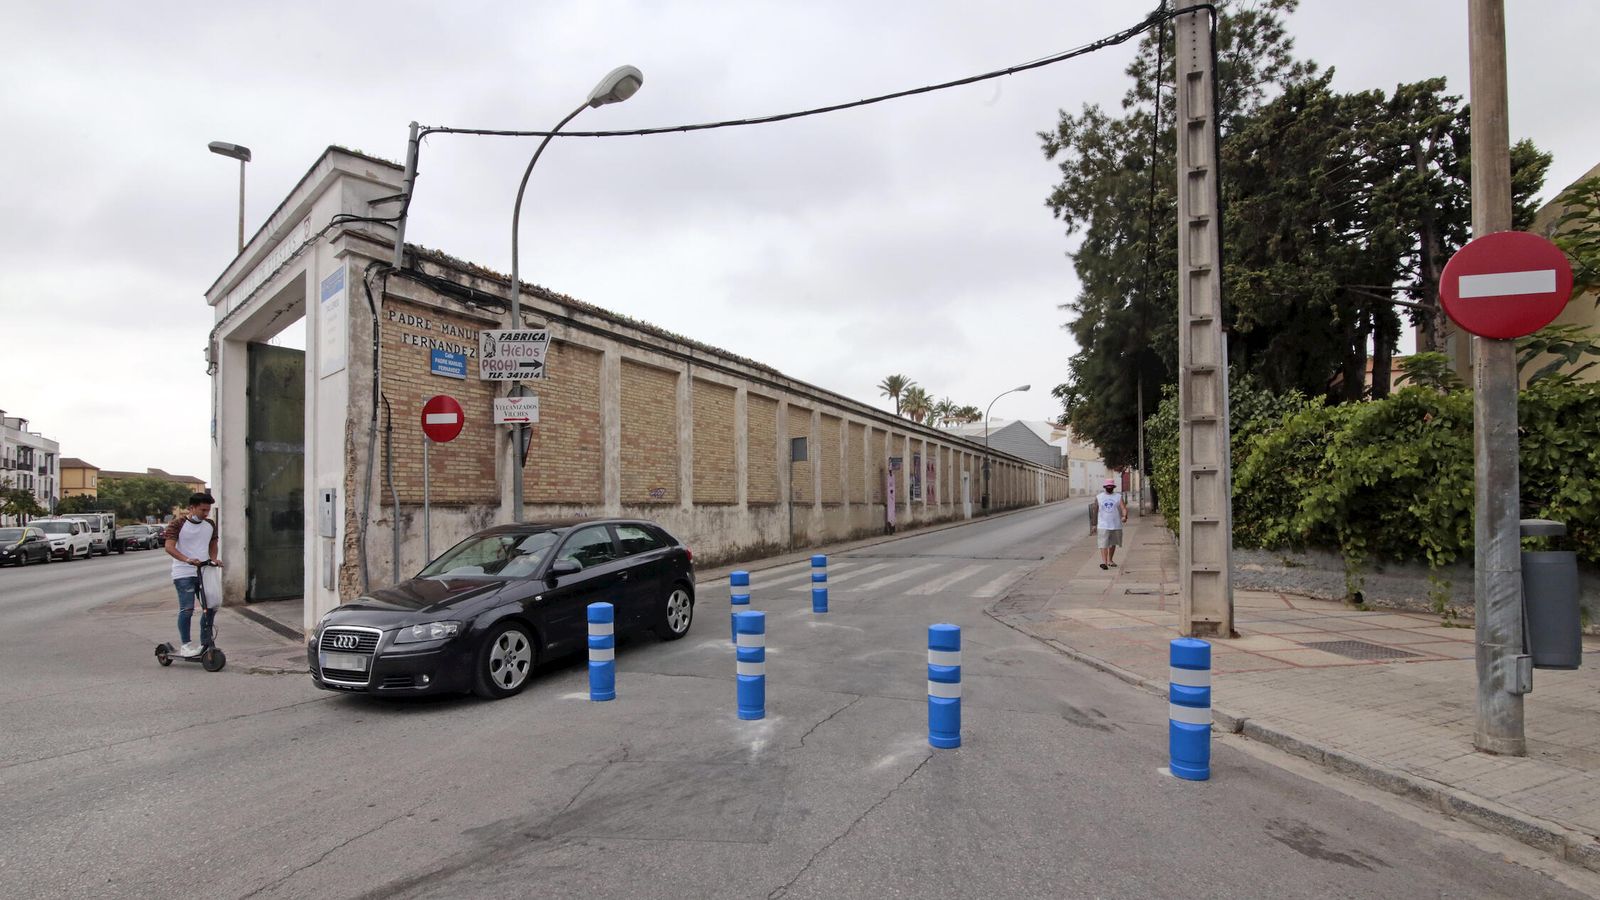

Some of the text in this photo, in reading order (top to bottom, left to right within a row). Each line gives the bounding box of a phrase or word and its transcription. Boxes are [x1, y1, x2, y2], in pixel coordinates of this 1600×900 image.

[388, 309, 480, 341] PADRE MANUE
[498, 332, 546, 341] FABRICA
[402, 333, 476, 358] FERNANDEZ
